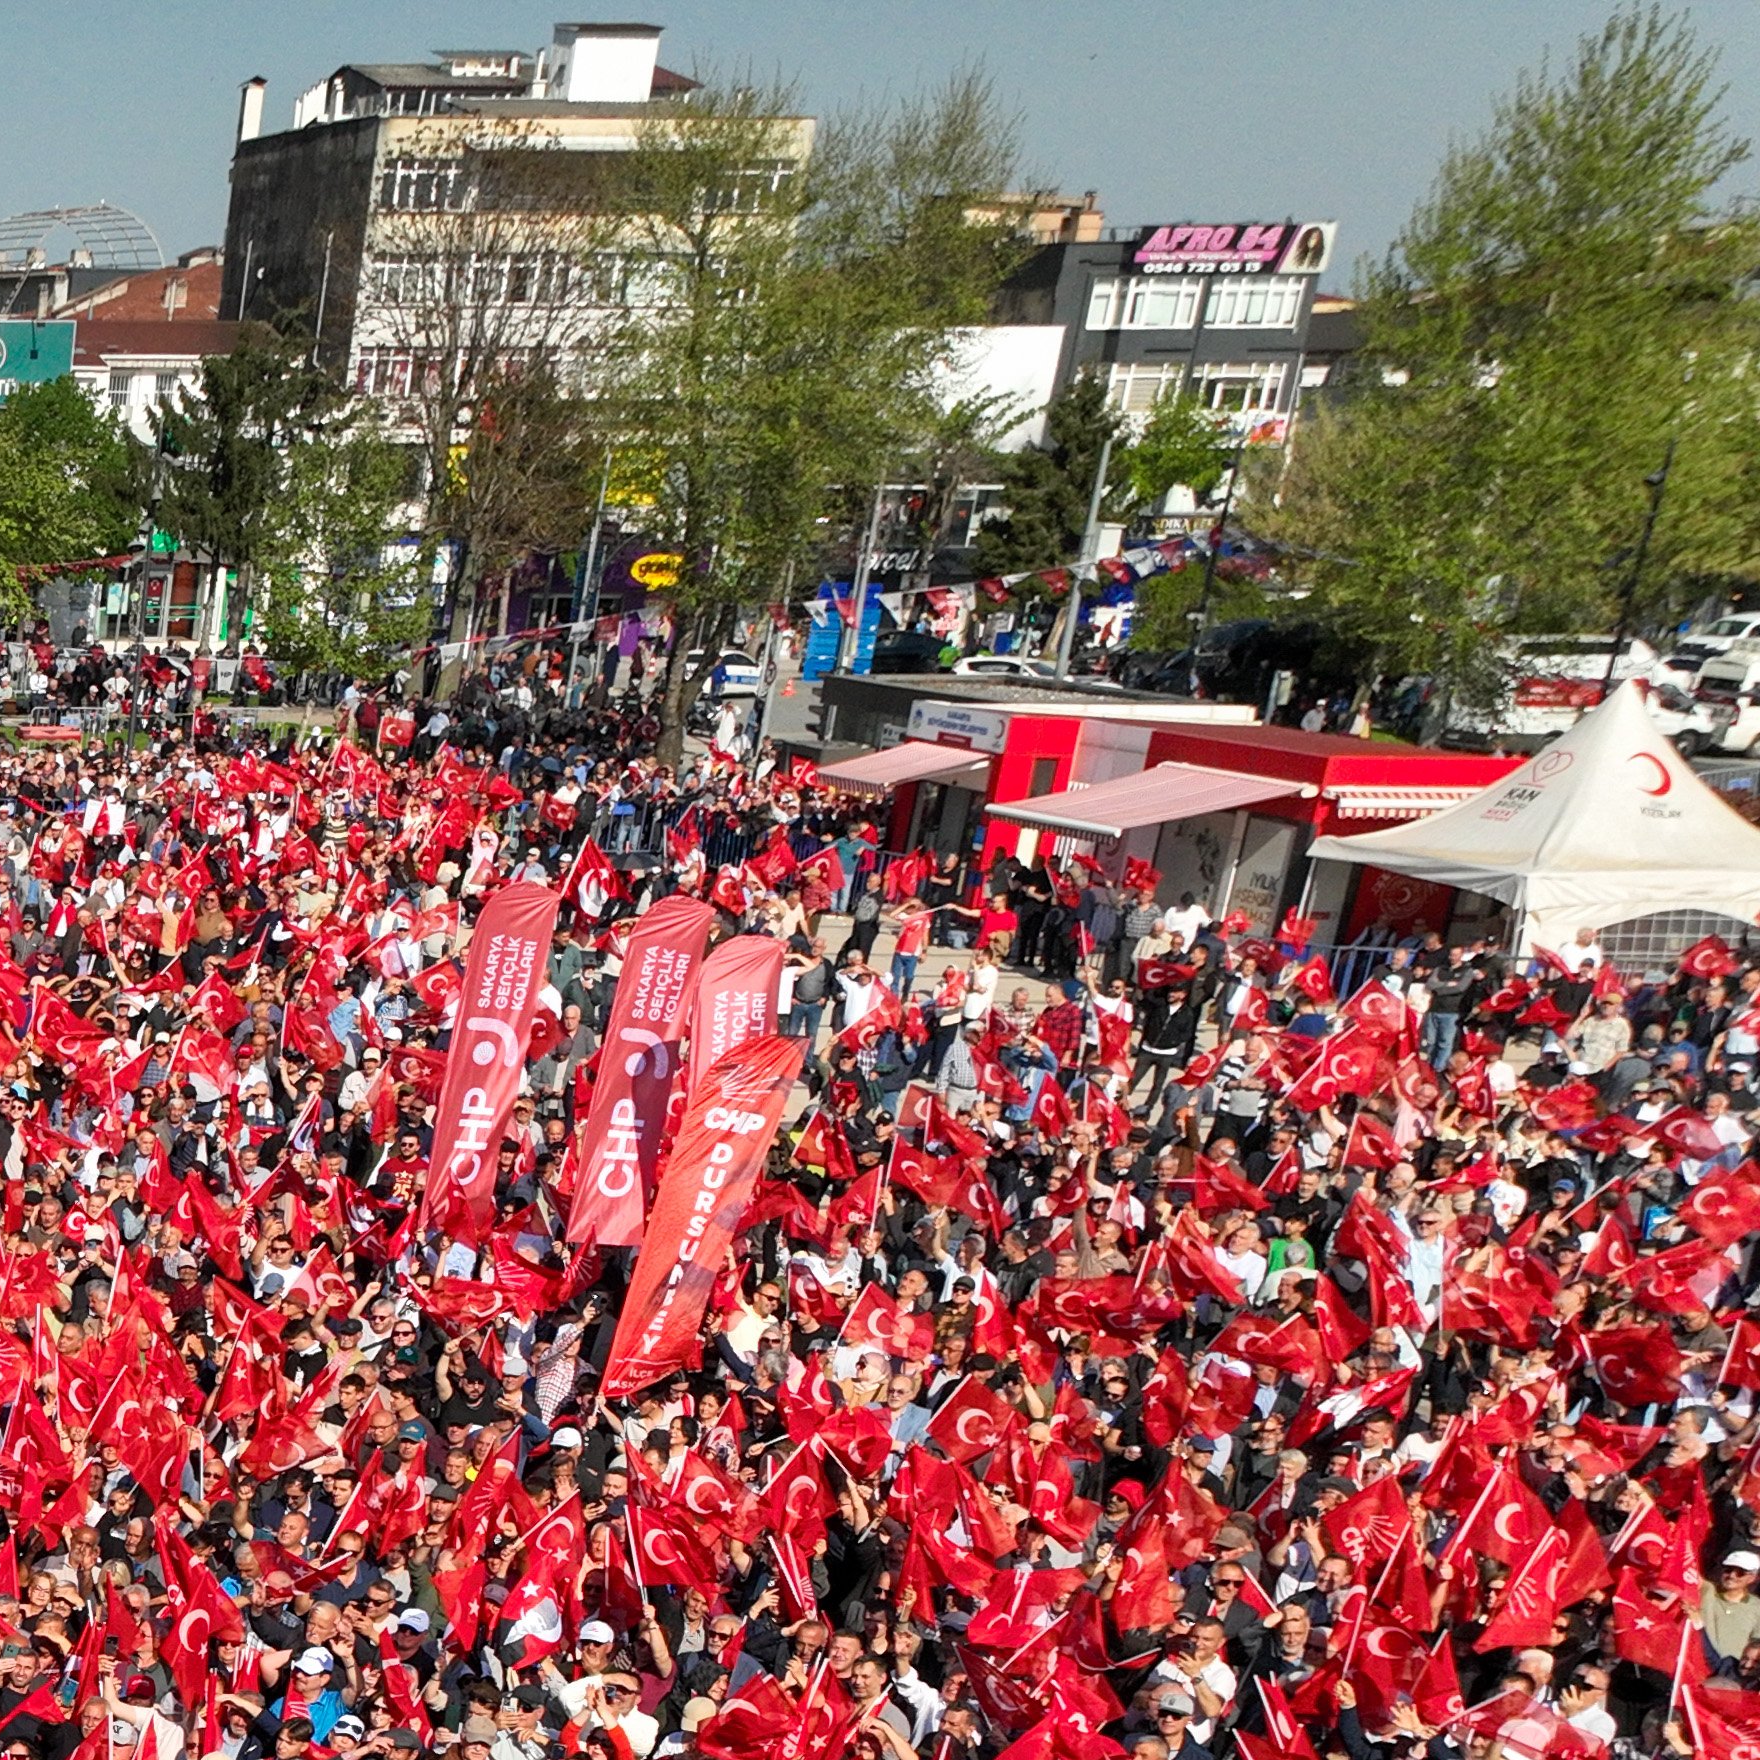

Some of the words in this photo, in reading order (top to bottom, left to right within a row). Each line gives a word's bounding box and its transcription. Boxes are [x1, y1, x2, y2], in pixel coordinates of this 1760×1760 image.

[1142, 227, 1234, 251] AFRO
[1237, 227, 1283, 250] 54
[1504, 788, 1541, 801] KAN
[476, 933, 505, 1008] SAKARYA
[494, 934, 523, 1015] GENÇLİK
[511, 939, 543, 1013] KOLLARI
[630, 944, 661, 1022] SAKARYA
[646, 948, 678, 1023] GENÇLİK
[447, 1085, 495, 1189] CHP
[599, 1096, 646, 1199] CHP
[704, 1108, 765, 1135] CHP
